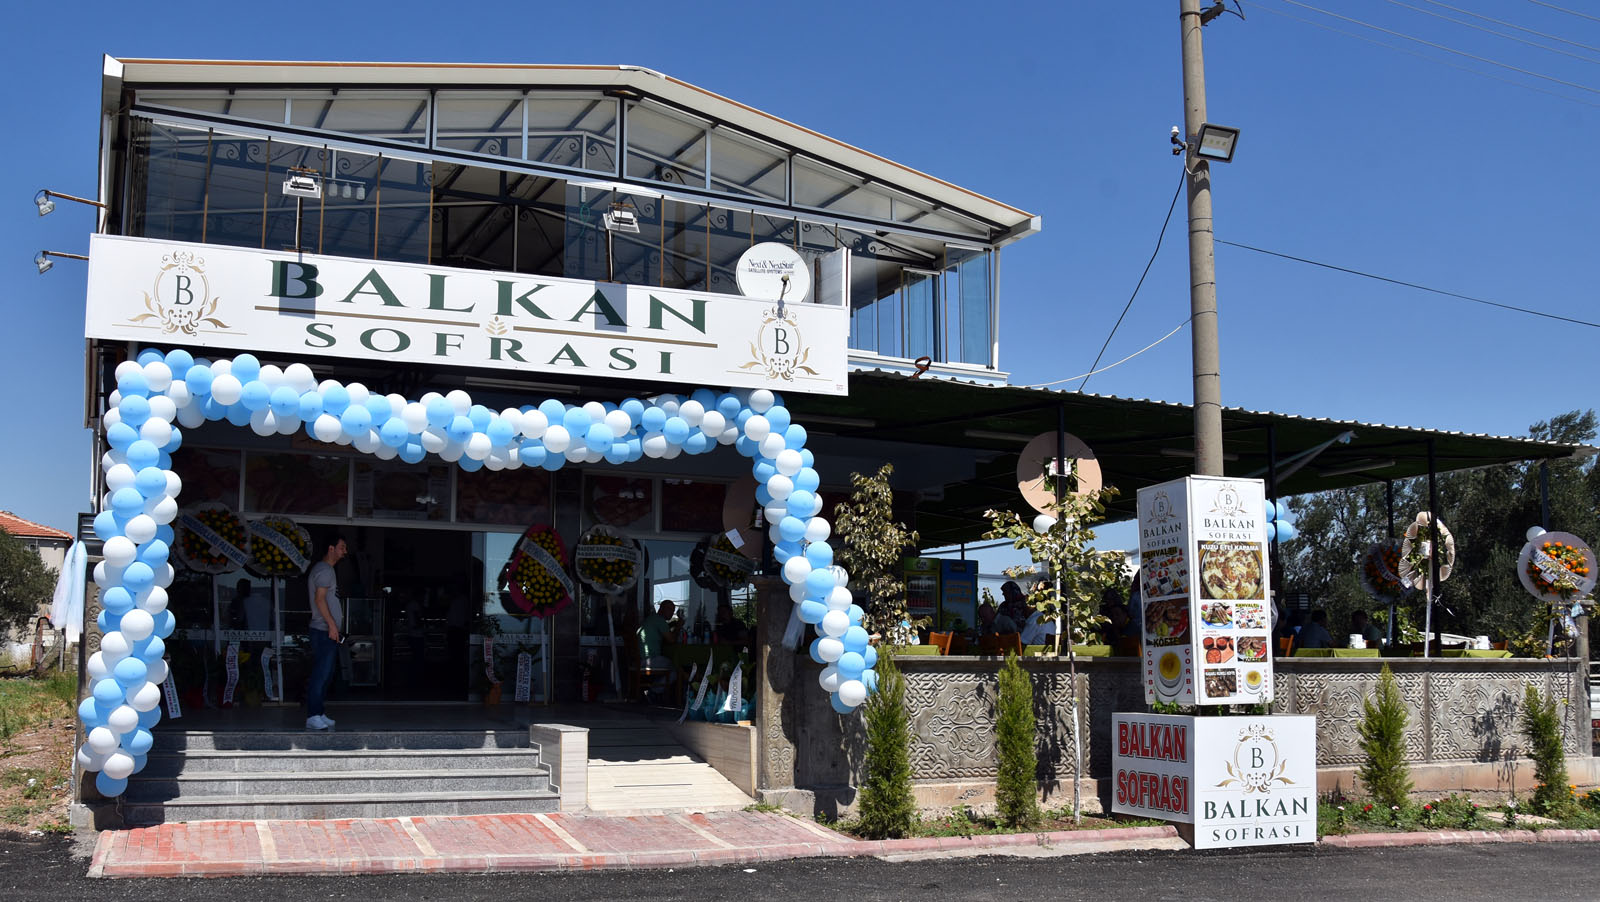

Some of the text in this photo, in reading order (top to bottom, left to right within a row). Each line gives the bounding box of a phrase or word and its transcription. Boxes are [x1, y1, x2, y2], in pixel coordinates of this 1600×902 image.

[174, 274, 194, 305] B
[264, 259, 712, 335] BALKAN
[304, 323, 675, 374] SOFRASI
[774, 328, 790, 355] B
[1143, 522, 1181, 538] BALKAN
[1204, 518, 1254, 529] BALKAN
[1147, 536, 1179, 549] SOFRASI
[1209, 532, 1251, 540] SOFRASI
[1118, 721, 1187, 763] BALKAN
[1251, 747, 1264, 768] B
[1117, 769, 1189, 814] SOFRASI
[1204, 797, 1308, 820] BALKAN
[1212, 825, 1299, 842] SOFRASI
